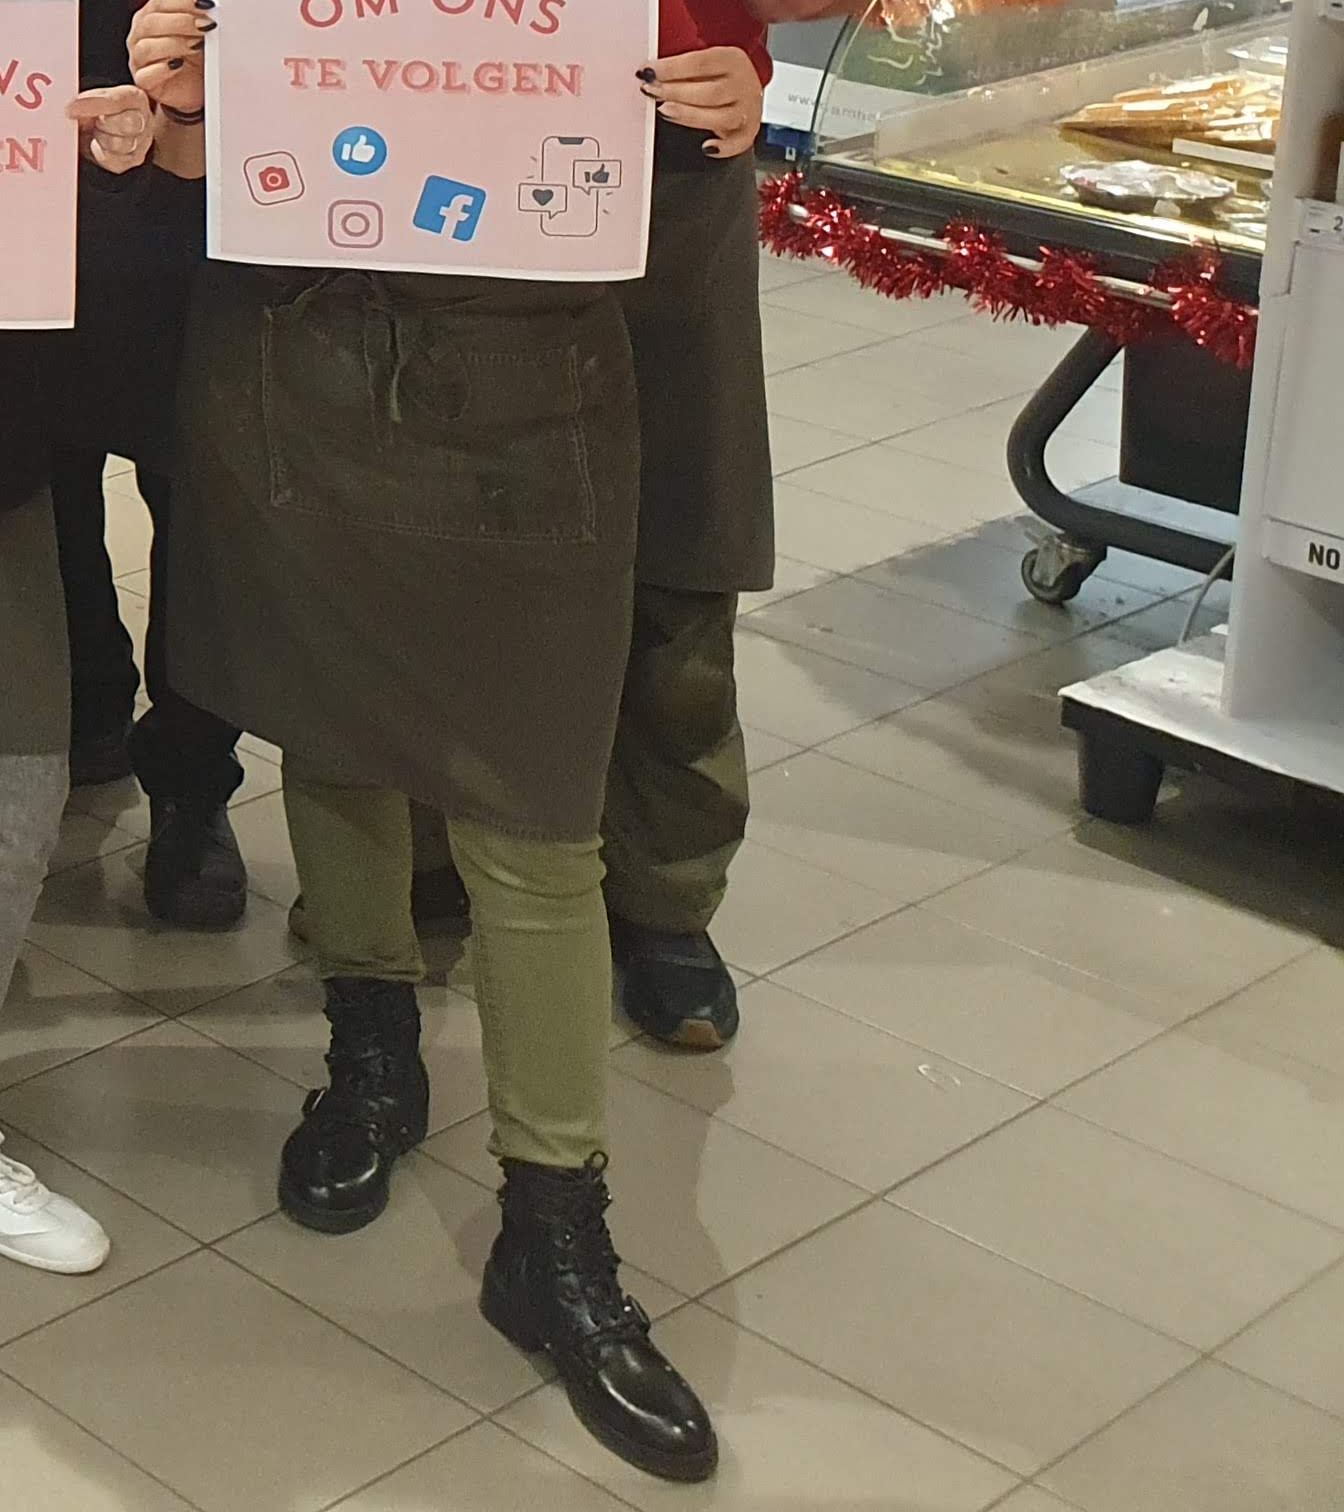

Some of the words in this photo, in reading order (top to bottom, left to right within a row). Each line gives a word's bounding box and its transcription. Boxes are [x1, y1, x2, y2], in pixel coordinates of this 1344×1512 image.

[284, 57, 347, 89] TE
[362, 59, 584, 96] VOLGEN
[1308, 541, 1341, 570] NO
